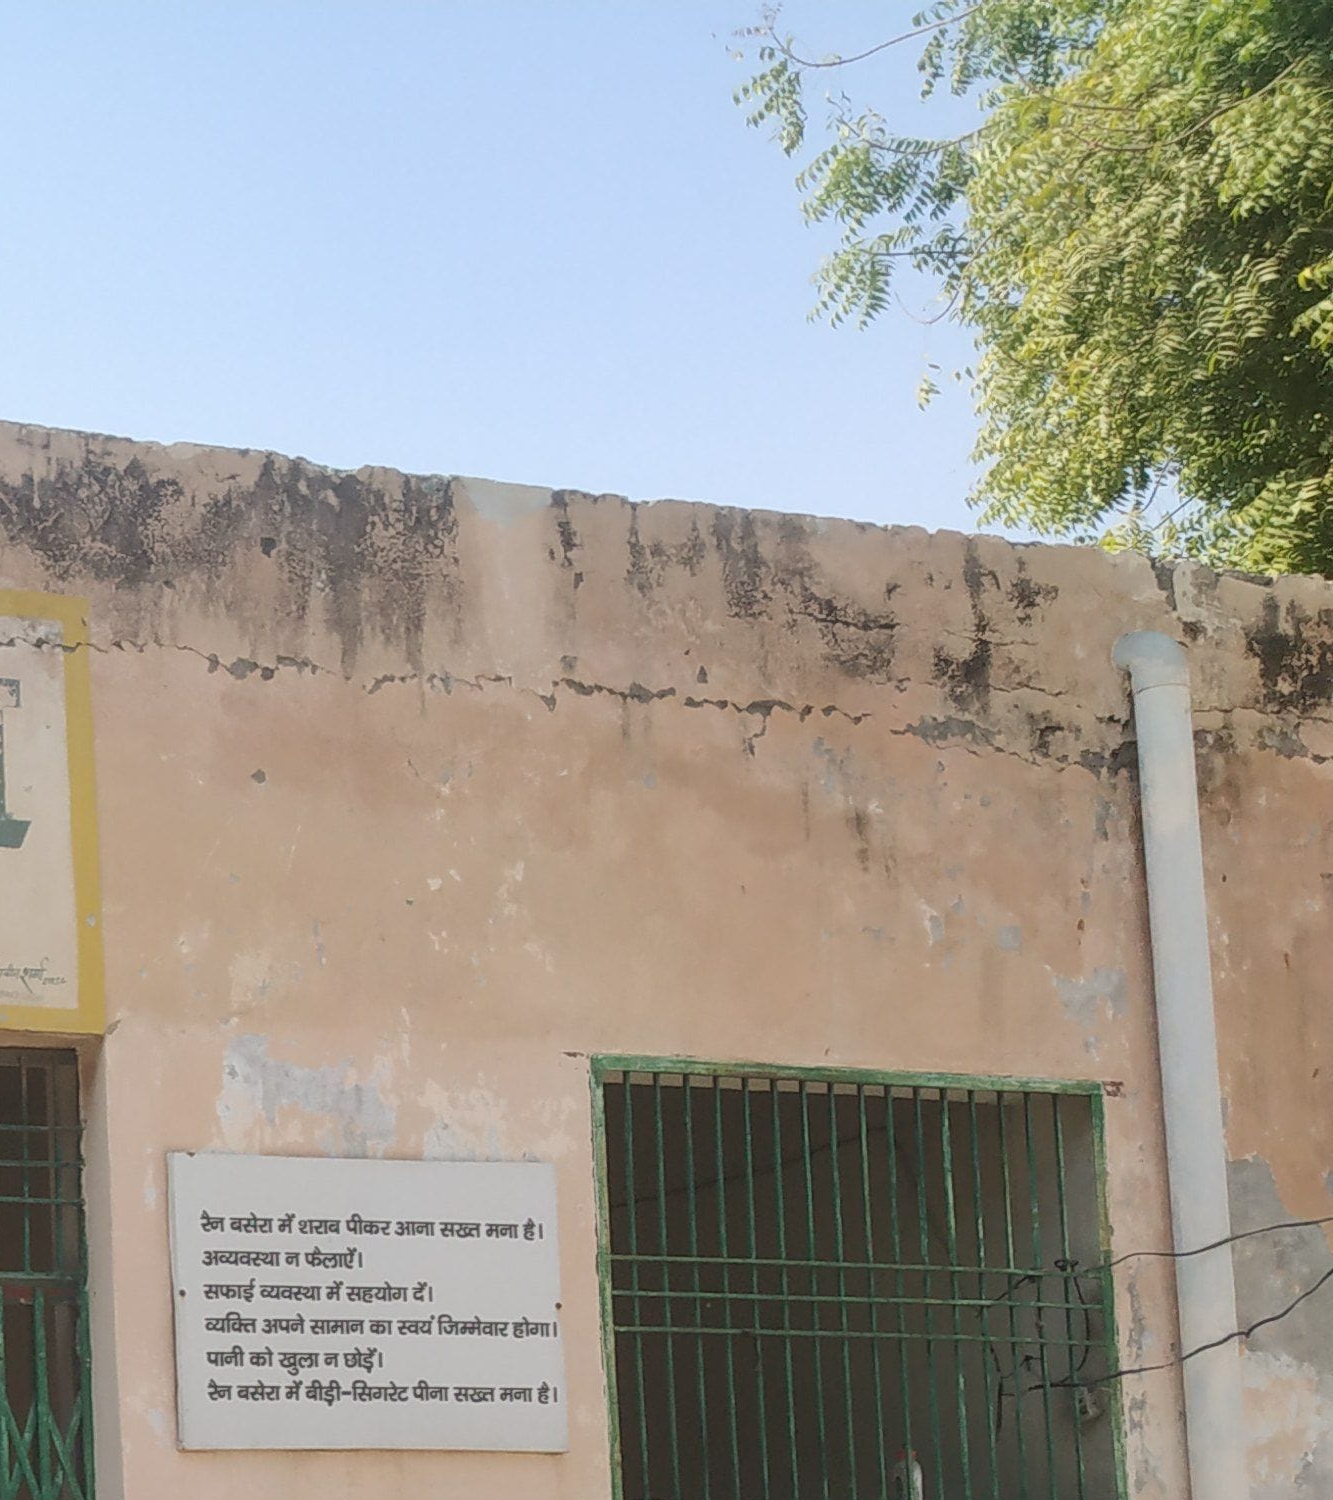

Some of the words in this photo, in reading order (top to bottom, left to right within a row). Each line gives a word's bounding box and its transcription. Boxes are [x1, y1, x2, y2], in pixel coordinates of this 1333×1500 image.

[200, 1210, 225, 1233] रैन
[229, 1212, 274, 1234] बसेरा
[277, 1213, 296, 1234] में
[298, 1219, 341, 1235] शराब
[346, 1213, 392, 1236] पीकर
[394, 1220, 434, 1237] आना
[439, 1221, 481, 1239] सख्त
[485, 1222, 519, 1239] मना
[202, 1250, 280, 1267] अव्यवस्था
[285, 1251, 301, 1267] न
[203, 1278, 256, 1302] सफाई
[259, 1283, 322, 1301] व्यवस्था
[325, 1281, 344, 1301] में
[345, 1282, 409, 1303] सहयोग
[205, 1311, 257, 1334] व्यक्ति
[262, 1313, 305, 1334] अपने
[309, 1319, 365, 1335] सामान
[369, 1319, 393, 1335] का
[397, 1315, 435, 1335] स्वयं
[437, 1314, 510, 1337] जिम्मेवार
[206, 1345, 245, 1367] पानी
[249, 1346, 274, 1367] को
[278, 1352, 320, 1376] खुला
[323, 1353, 339, 1368] न
[207, 1378, 233, 1401] रैन
[237, 1380, 281, 1401] बसेरा
[285, 1380, 303, 1401] में
[413, 1380, 450, 1402] पीना
[453, 1387, 496, 1403] सख्त
[500, 1387, 533, 1403] मना
